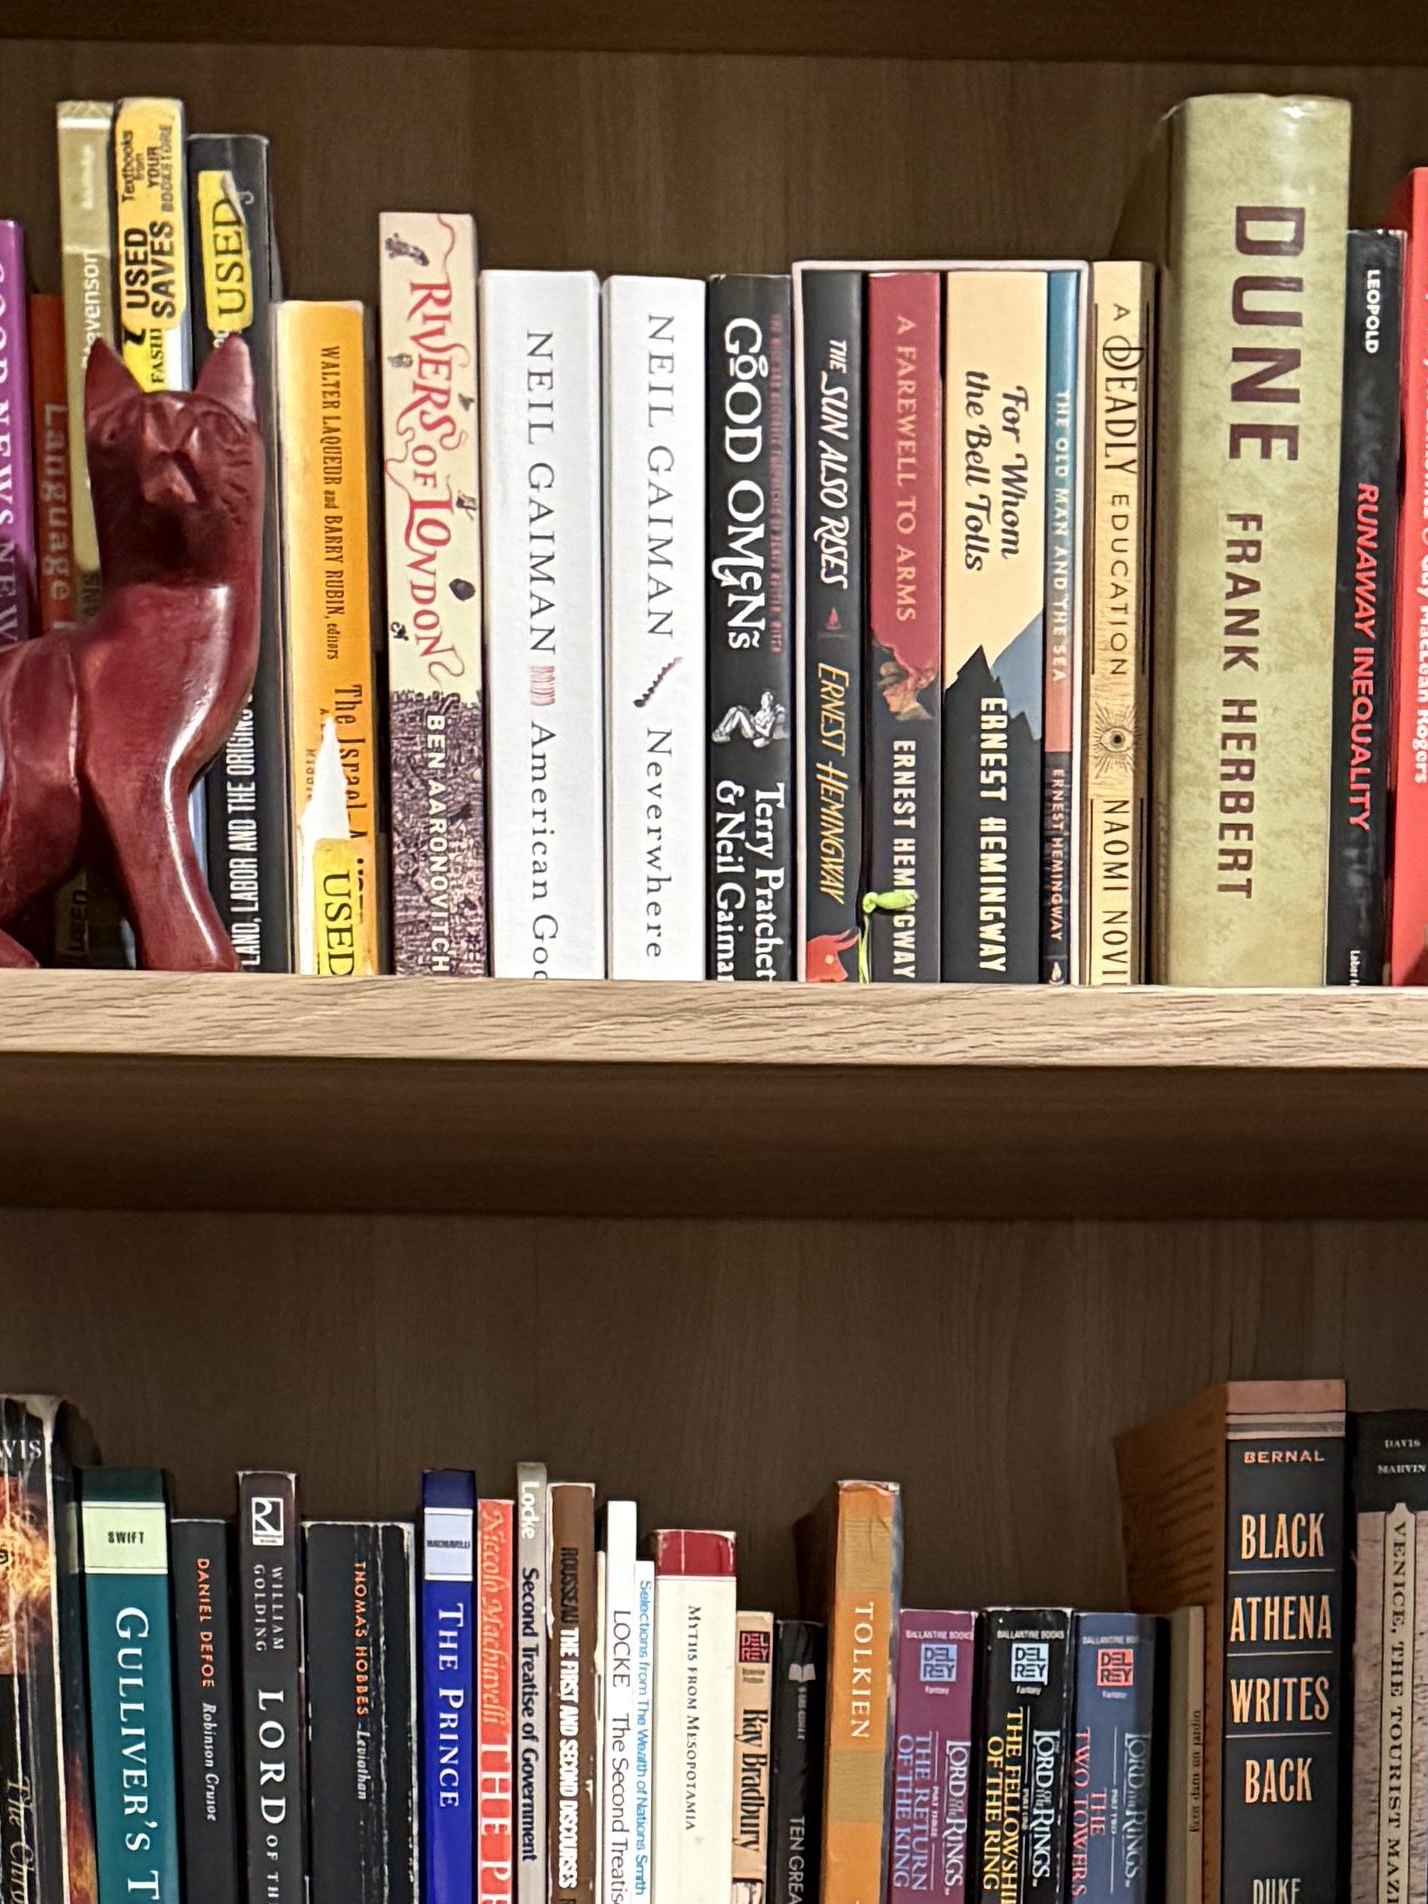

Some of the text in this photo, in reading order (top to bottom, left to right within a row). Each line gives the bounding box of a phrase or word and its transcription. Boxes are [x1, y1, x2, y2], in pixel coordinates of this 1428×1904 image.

[123, 227, 149, 310] USED
[149, 220, 175, 319] SAVES
[816, 340, 849, 589] THE SUN ALSO RISES
[964, 371, 992, 573] the Bell Tolls
[999, 385, 1030, 561] For Whom
[1215, 202, 1307, 901] DUNE FRANK HERBERT
[526, 329, 563, 900] NEIL GAIMAN American
[644, 313, 675, 960] NEIL GAIMAN Neverwhere
[422, 715, 451, 974] BEN AARONOVITCH
[979, 696, 1008, 973] ERNEST HEMINGWAY
[107, 1529, 146, 1547] SWIFT
[1240, 1513, 1325, 1559] BLACK
[1243, 1450, 1325, 1464] BERNAL
[438, 1602, 464, 1809] THE PRINCE
[851, 1602, 876, 1740] TOLKIEN
[1230, 1595, 1332, 1643] ATHENA
[1230, 1677, 1330, 1724] WRITES
[115, 1605, 159, 1853] GULLIVER'S
[1244, 1757, 1313, 1804] BACK
